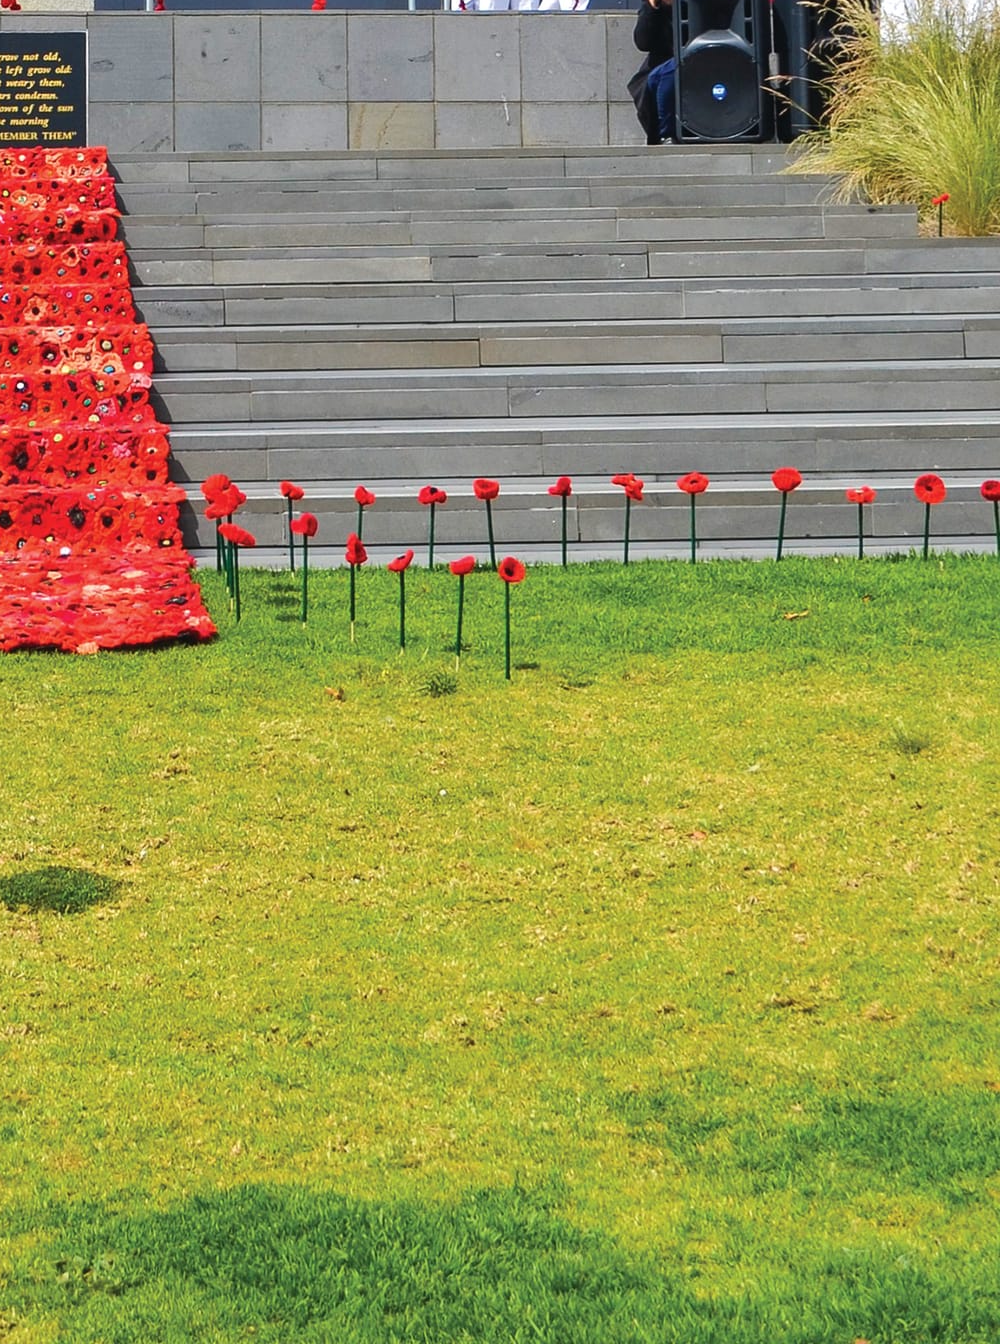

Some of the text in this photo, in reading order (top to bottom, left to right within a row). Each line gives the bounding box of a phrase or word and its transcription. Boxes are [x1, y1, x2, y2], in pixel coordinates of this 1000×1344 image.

[23, 53, 39, 61] not
[43, 52, 62, 62] old,
[5, 65, 23, 77] left
[27, 67, 51, 77] grow
[6, 80, 35, 90] weary
[39, 78, 65, 88] them,
[15, 91, 59, 100] condemn.
[22, 104, 34, 115] of
[38, 104, 53, 113] the
[57, 105, 74, 113] sun
[10, 117, 49, 128] morning
